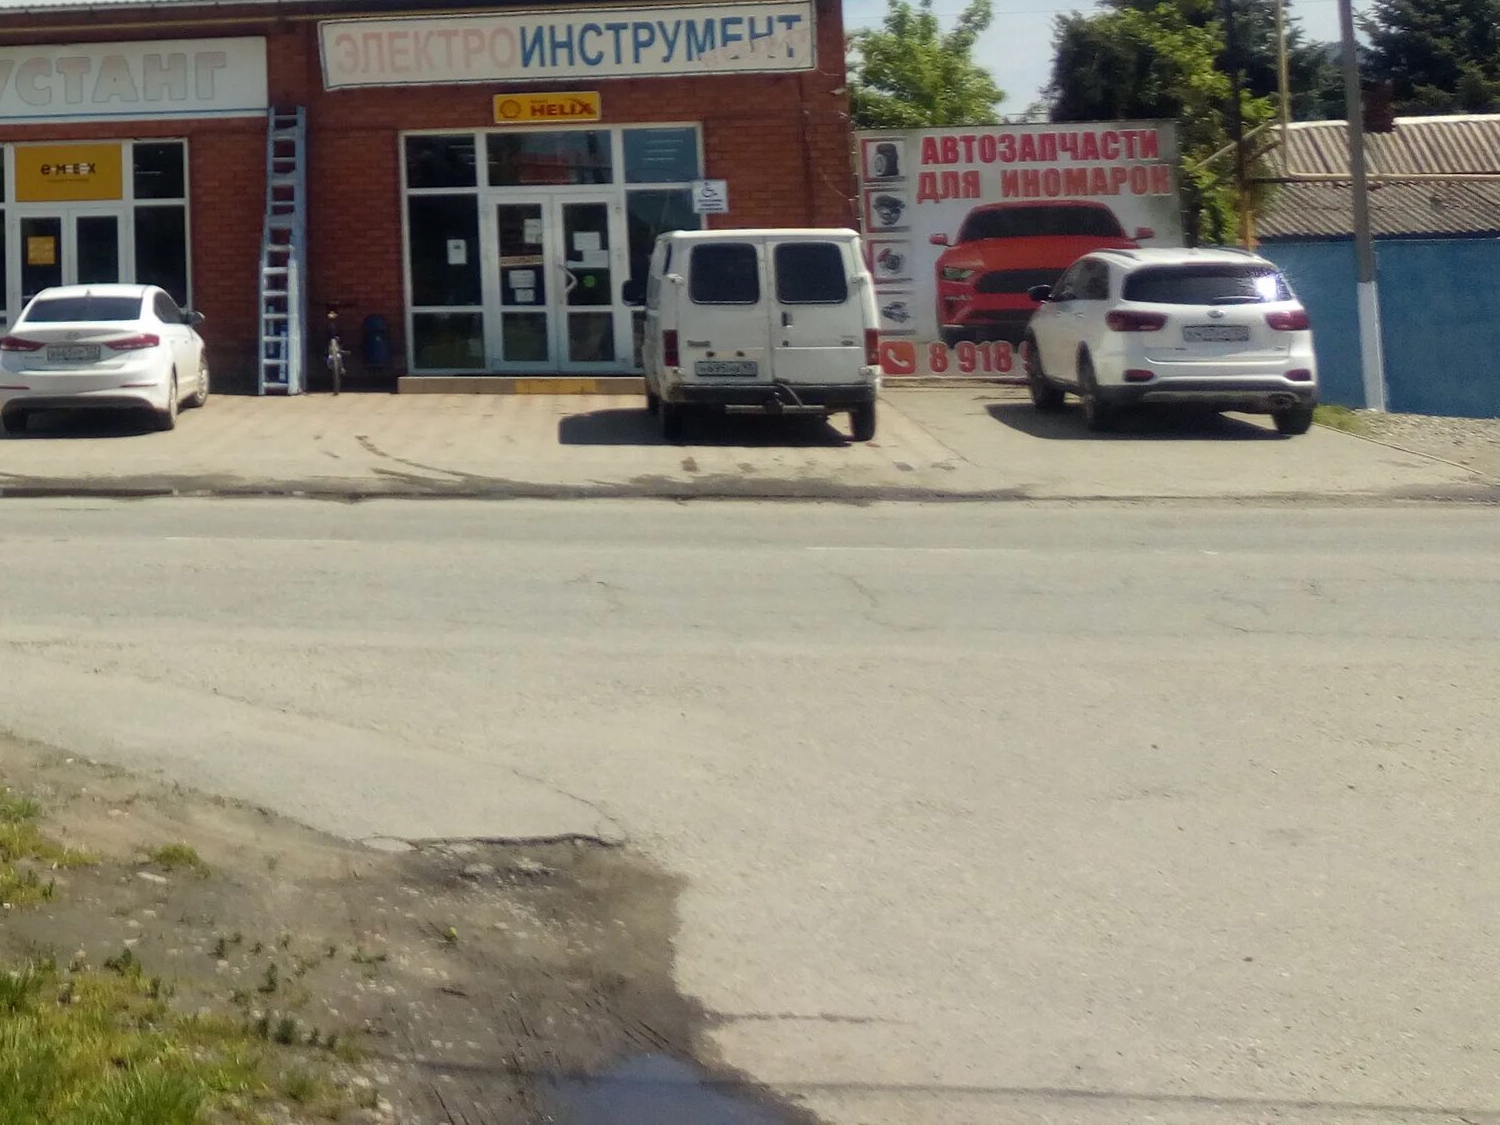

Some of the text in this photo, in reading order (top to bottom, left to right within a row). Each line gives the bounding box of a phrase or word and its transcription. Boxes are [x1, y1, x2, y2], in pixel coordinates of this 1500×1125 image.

[334, 13, 803, 76] ЭЛЕКТРОИНСТРУМЕНТ
[530, 99, 597, 117] HELIX
[920, 128, 1160, 166] АВТОЗАПЧАСТИ
[916, 164, 1173, 205] ДЛЯ ИНОМАРОК
[928, 340, 949, 374] 8
[956, 340, 1013, 374] 918
